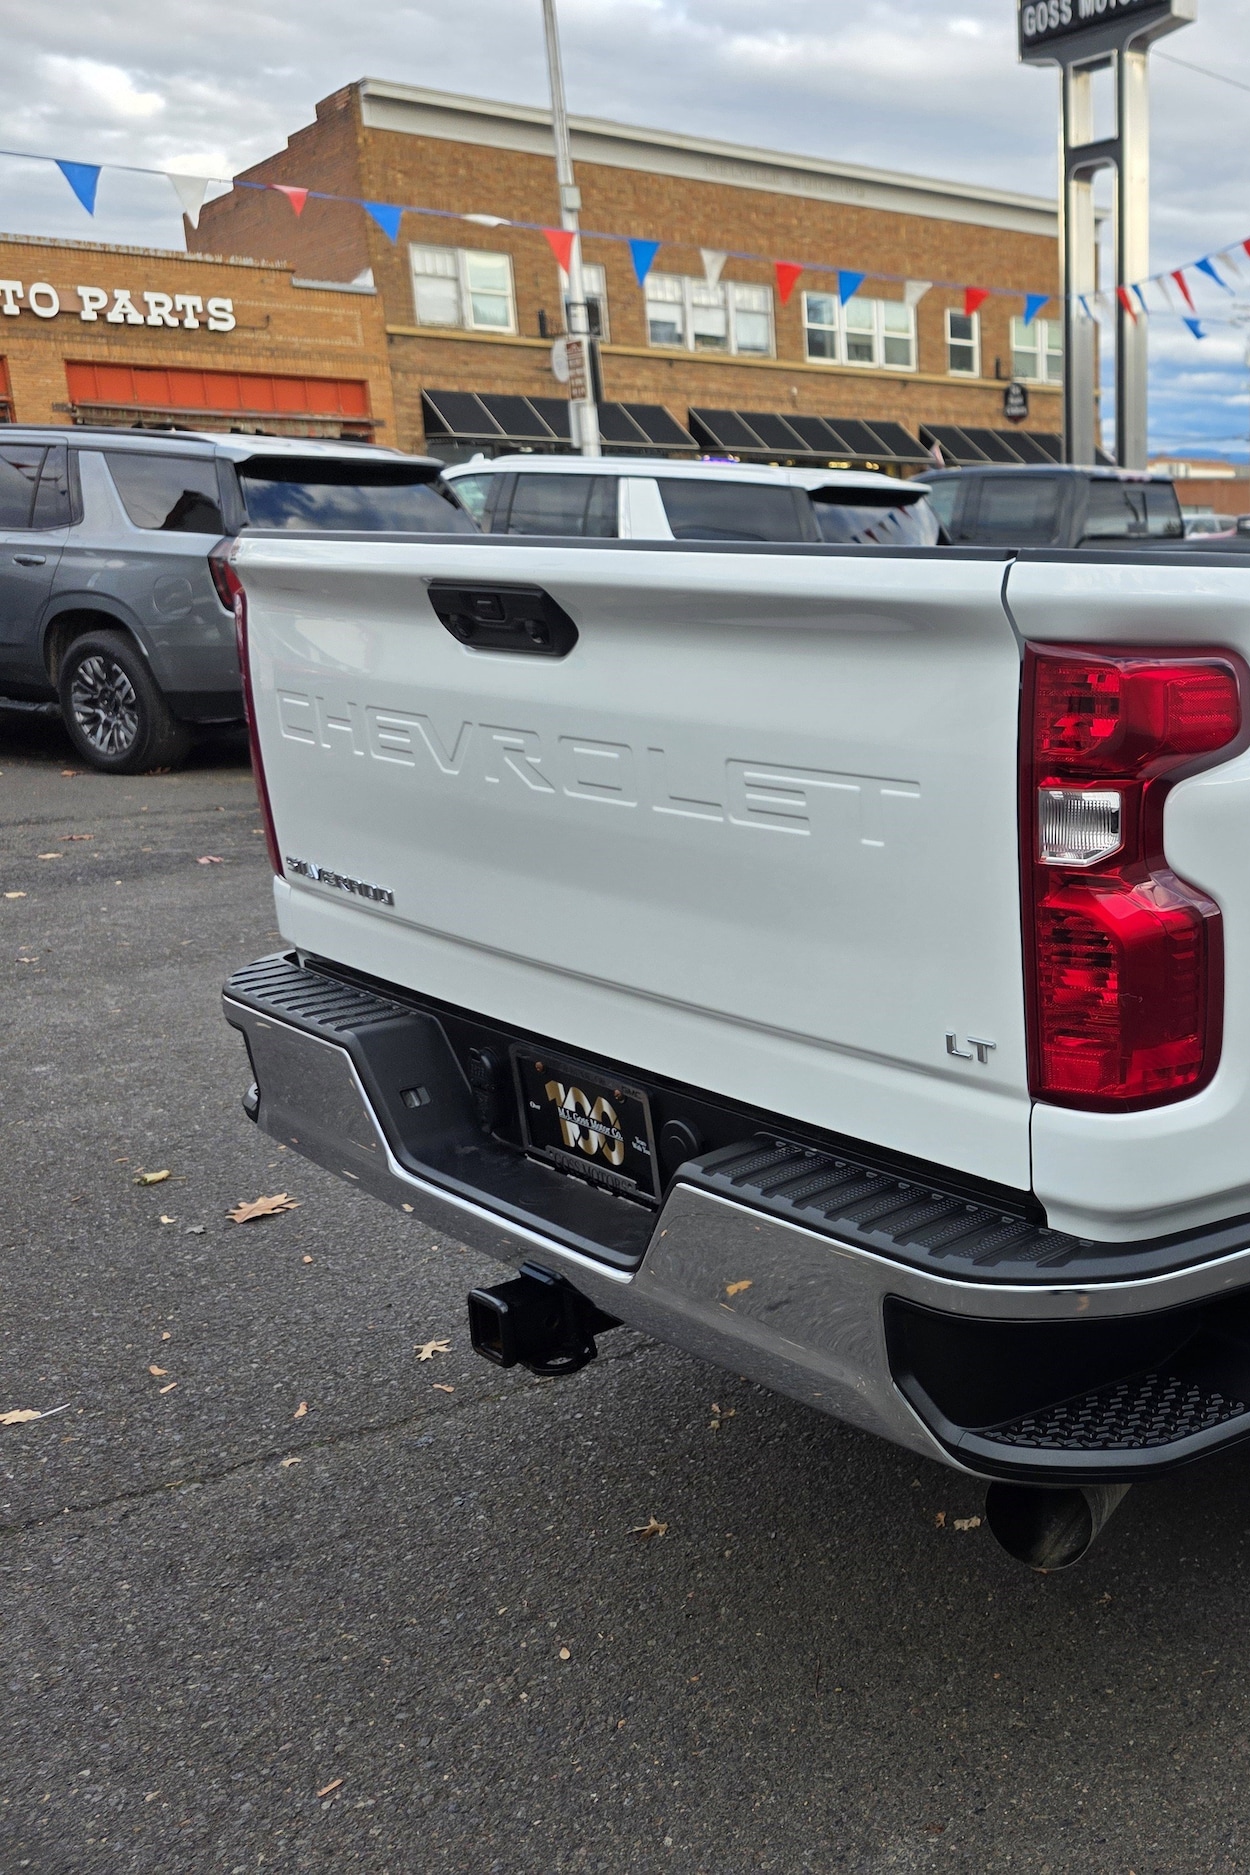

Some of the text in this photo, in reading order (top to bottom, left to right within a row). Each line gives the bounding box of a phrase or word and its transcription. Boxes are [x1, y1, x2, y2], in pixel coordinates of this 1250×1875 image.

[1023, 0, 1073, 36] GOSS
[77, 285, 236, 332] PARTS
[277, 688, 922, 847] CHEVROLET
[286, 856, 395, 906] SILVERADO
[945, 1031, 996, 1064] LT
[544, 1080, 625, 1166] 100
